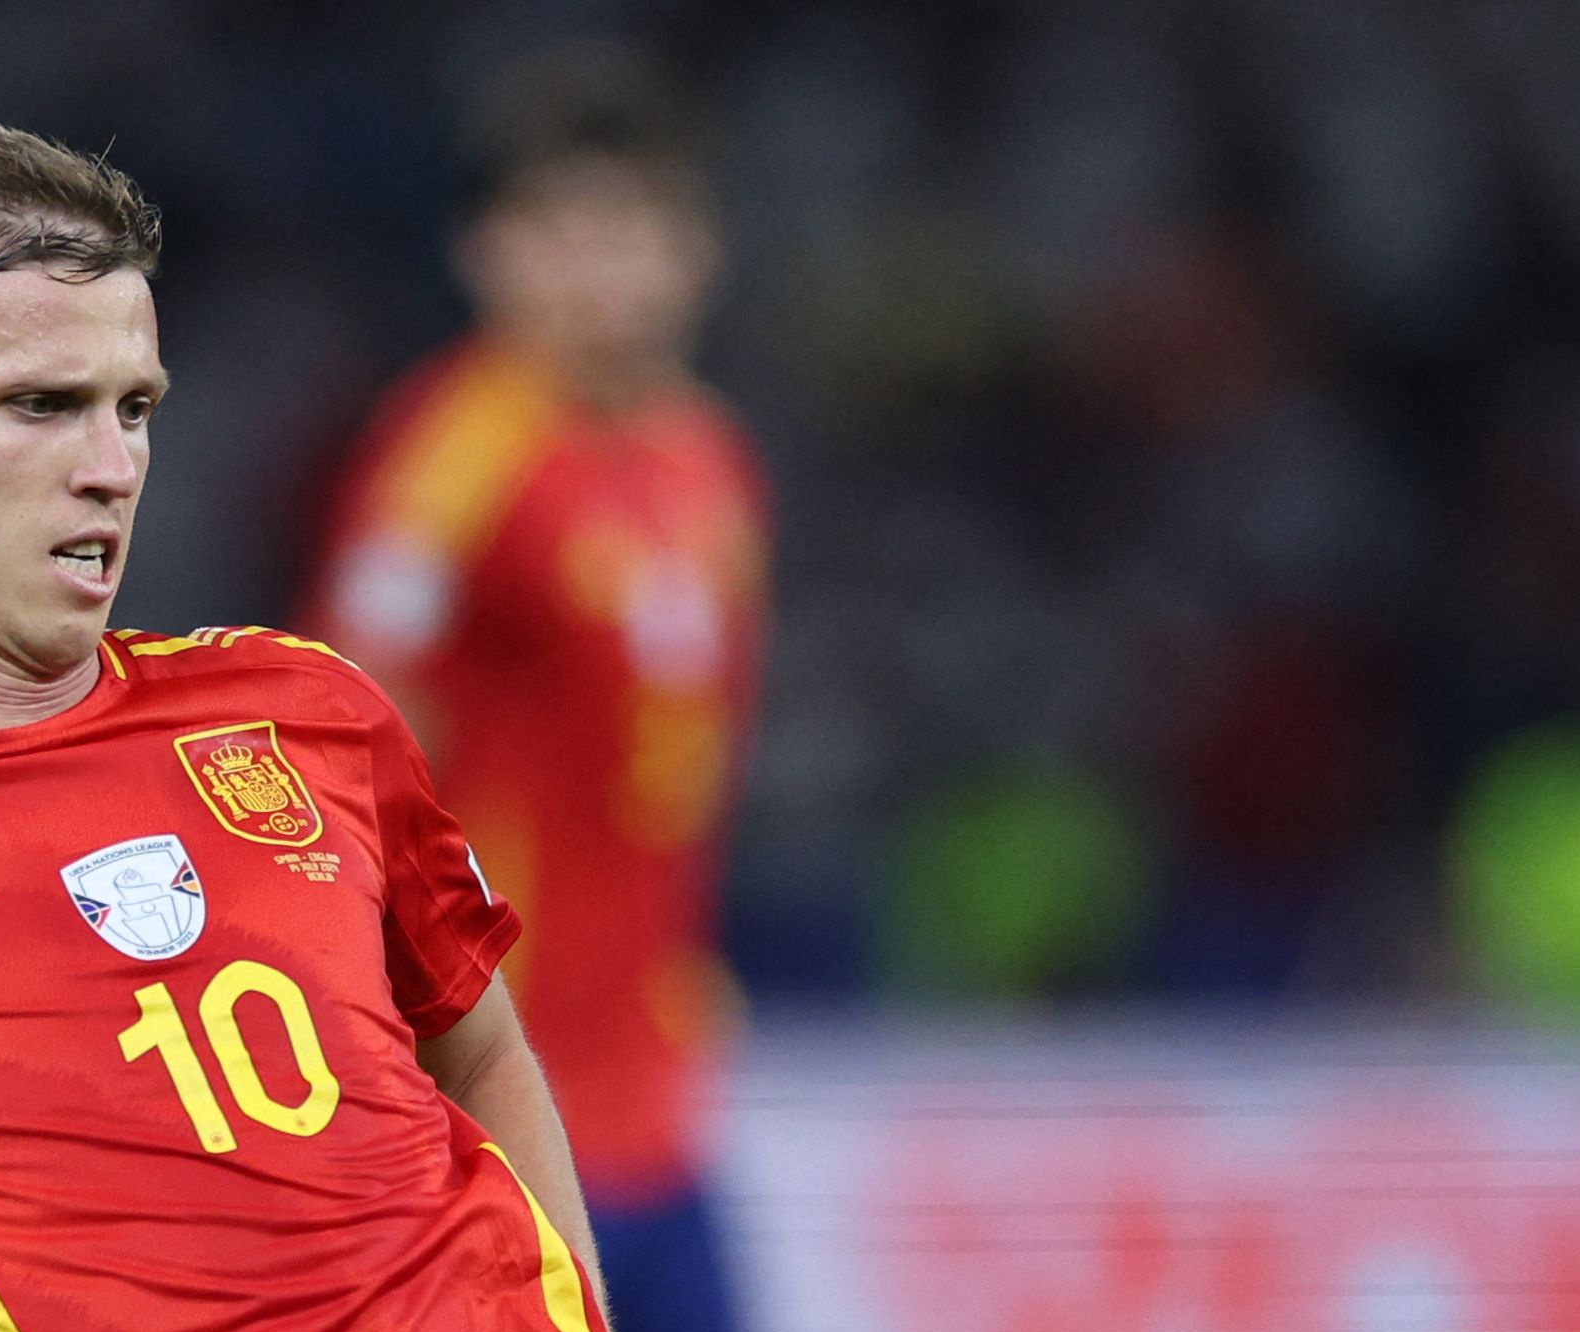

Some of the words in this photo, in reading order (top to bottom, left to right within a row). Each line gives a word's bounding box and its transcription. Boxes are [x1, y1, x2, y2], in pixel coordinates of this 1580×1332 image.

[69, 865, 91, 877] UEFA
[93, 847, 134, 866] NATIONS
[135, 841, 173, 852] LEAGUE
[117, 960, 340, 1154] 10
